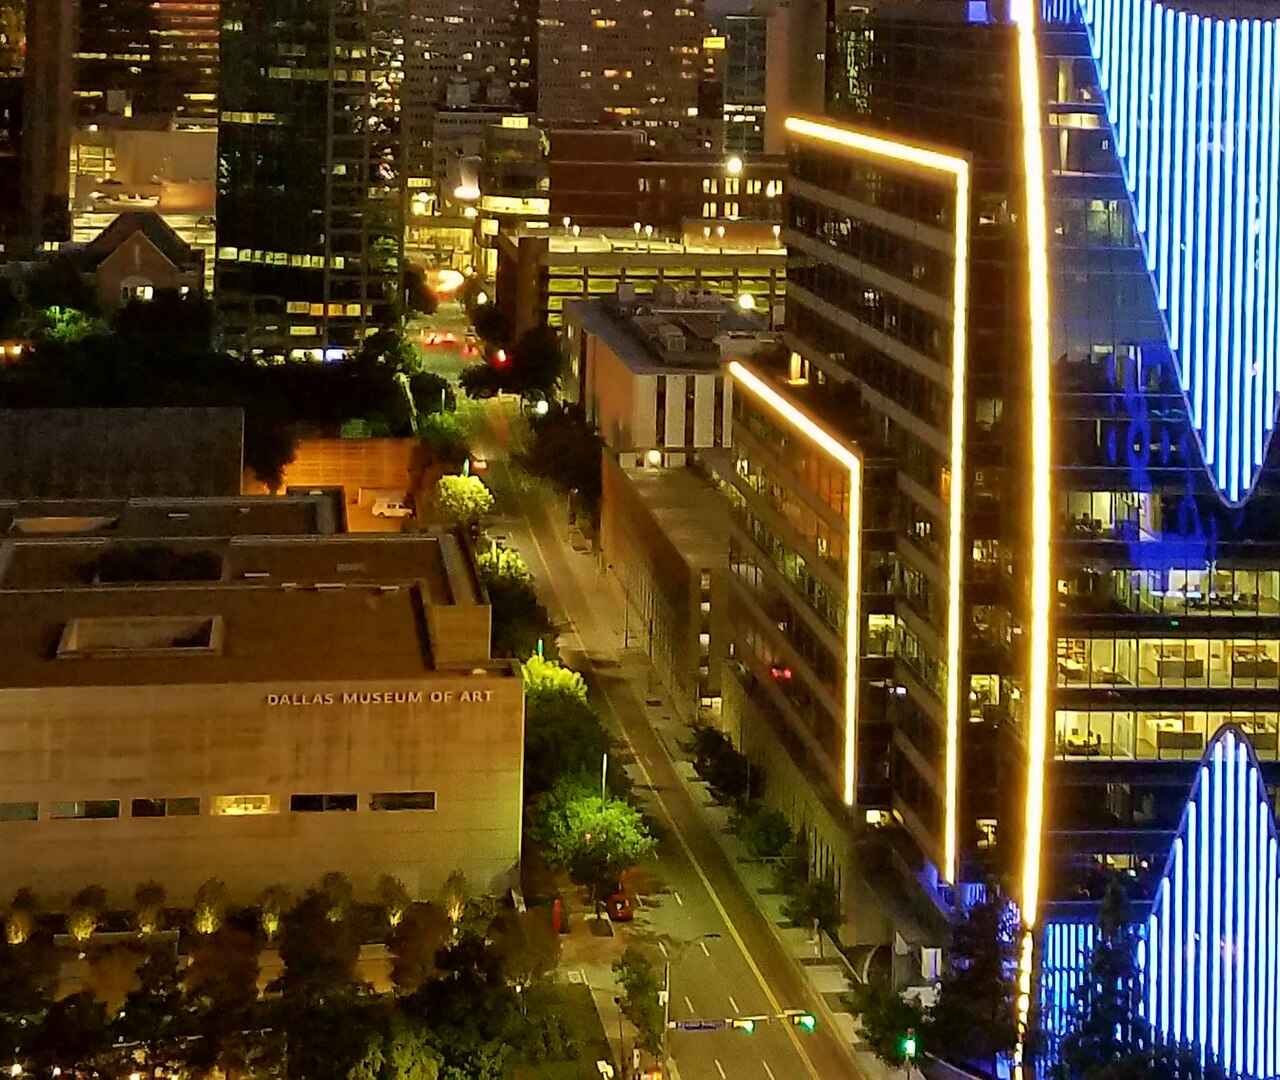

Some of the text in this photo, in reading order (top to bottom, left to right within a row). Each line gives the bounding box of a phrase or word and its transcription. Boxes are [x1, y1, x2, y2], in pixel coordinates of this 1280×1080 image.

[267, 690, 495, 706] DALLAS MUSEUM OF ART
